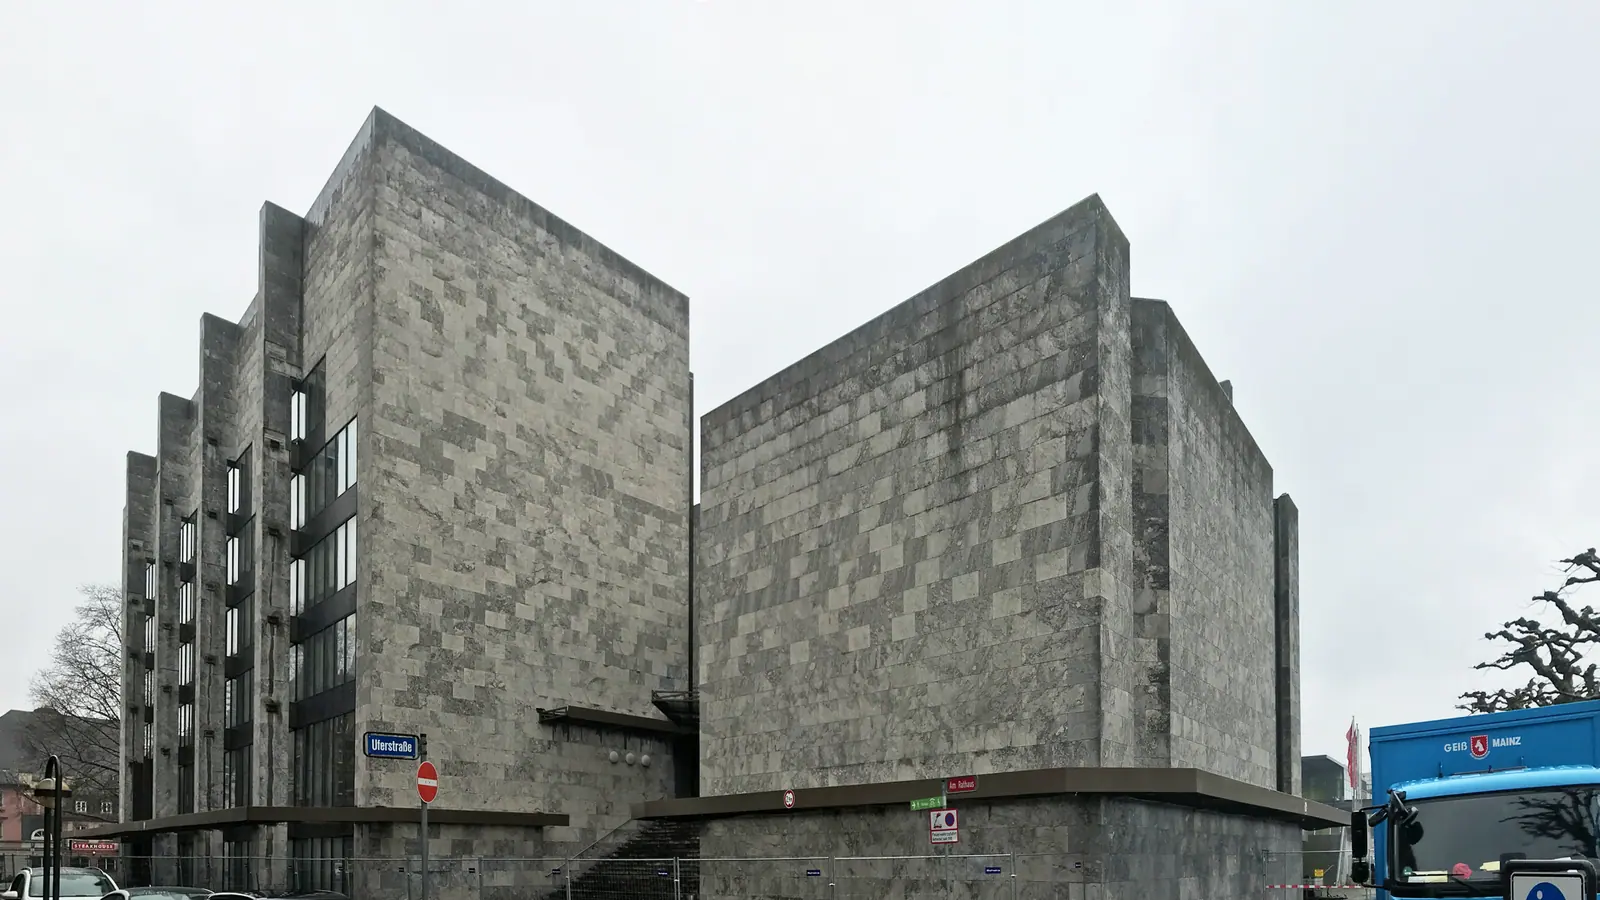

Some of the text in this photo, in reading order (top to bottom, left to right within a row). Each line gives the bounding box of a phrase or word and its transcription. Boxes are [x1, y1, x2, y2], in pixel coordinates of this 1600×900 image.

[371, 738, 412, 753] Uferstraße
[1492, 736, 1522, 747] MAINZ
[949, 780, 975, 789] Am Rathaus
